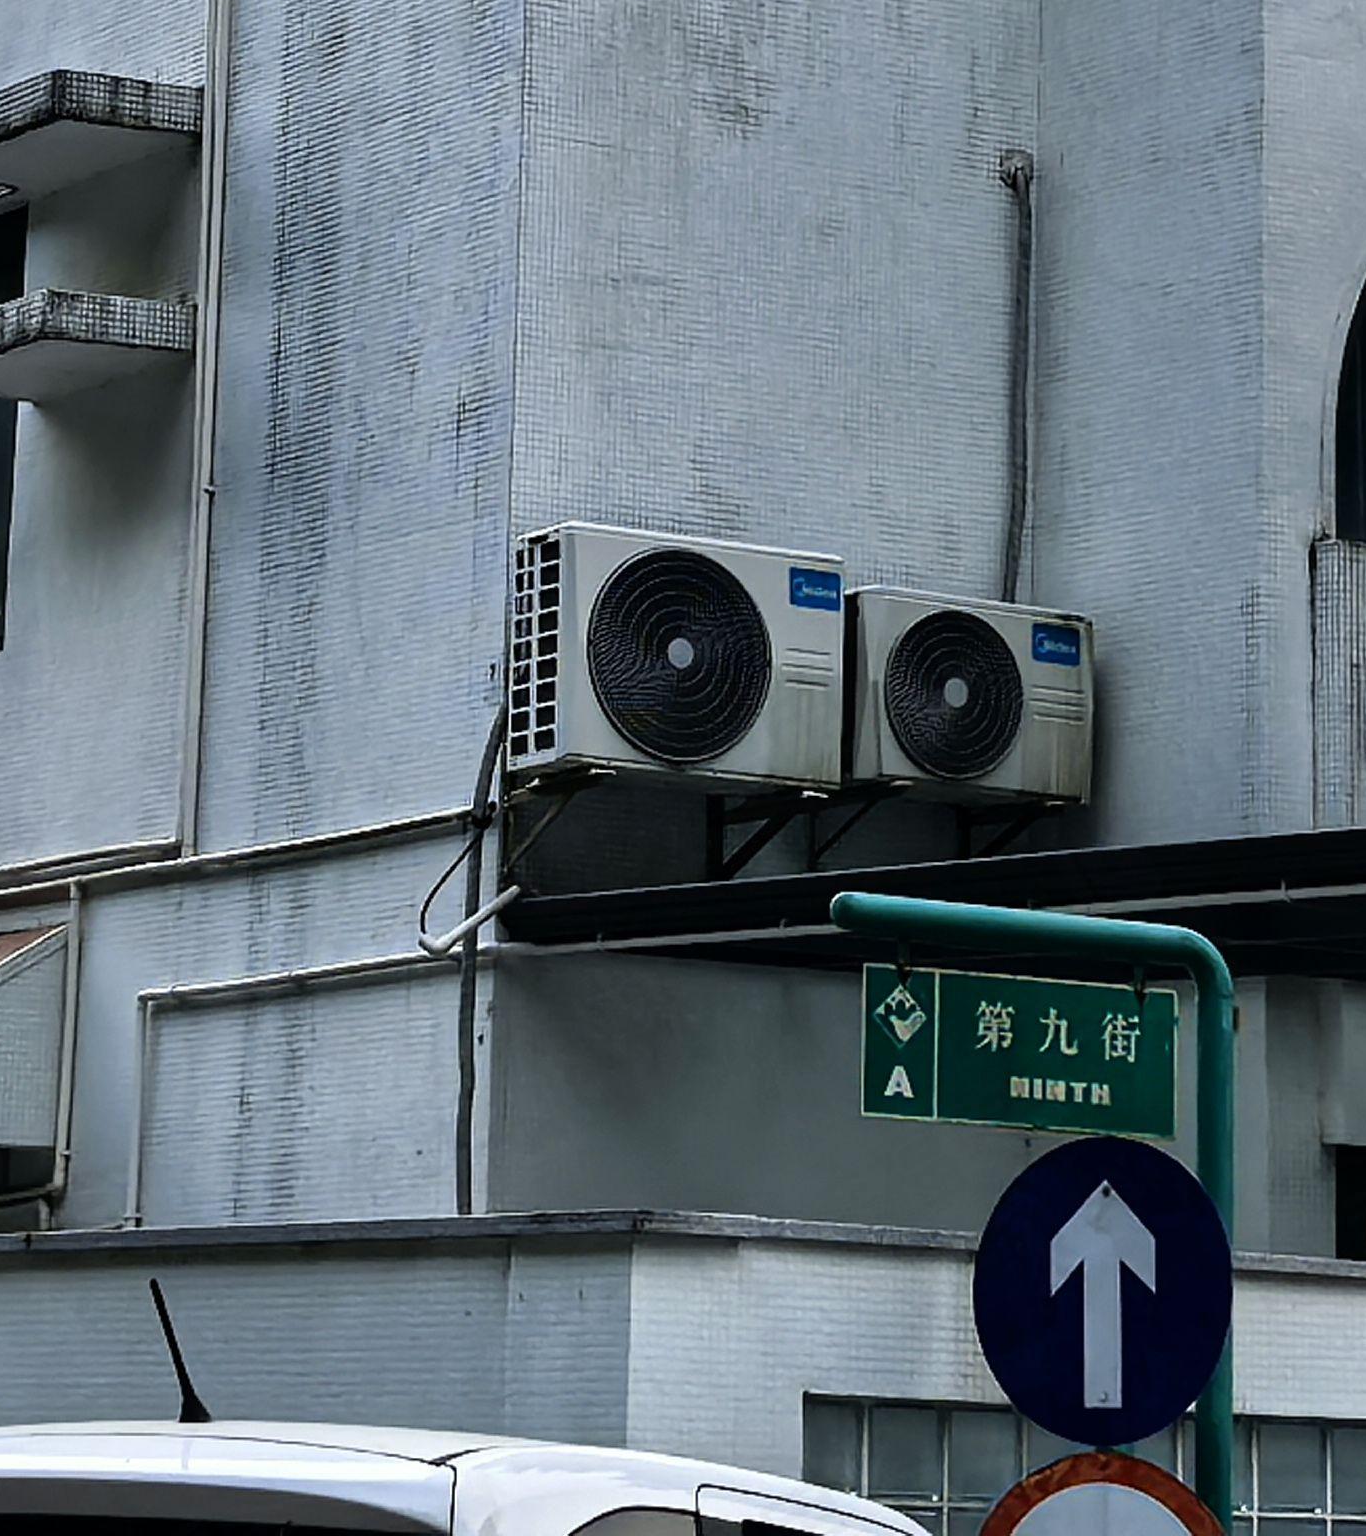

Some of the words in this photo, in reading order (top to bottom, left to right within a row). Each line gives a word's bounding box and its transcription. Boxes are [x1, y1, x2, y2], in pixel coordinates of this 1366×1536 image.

[975, 1001, 1140, 1063] 第九街
[884, 1066, 914, 1098] A
[1010, 1075, 1112, 1106] NINTH
